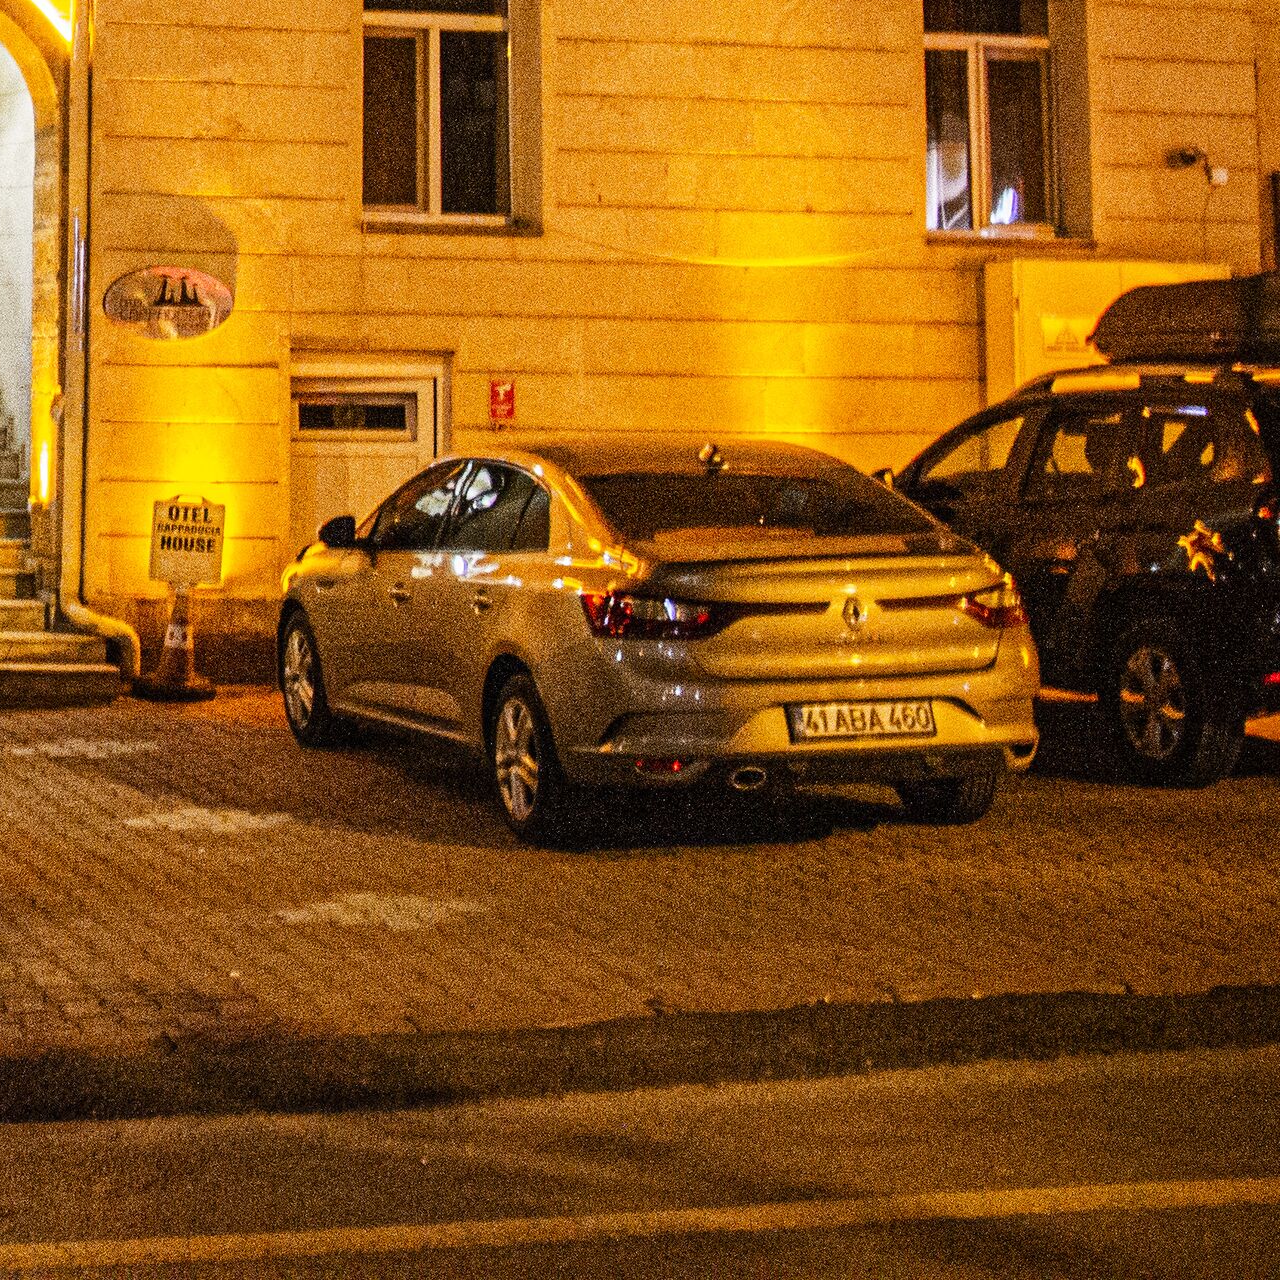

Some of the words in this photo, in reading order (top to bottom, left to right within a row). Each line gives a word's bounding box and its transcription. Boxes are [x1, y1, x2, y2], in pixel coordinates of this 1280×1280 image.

[168, 505, 213, 524] OTEL
[160, 535, 216, 553] HOUSE
[805, 708, 829, 733] 41
[835, 706, 885, 732] ABA
[888, 704, 930, 730] 460
